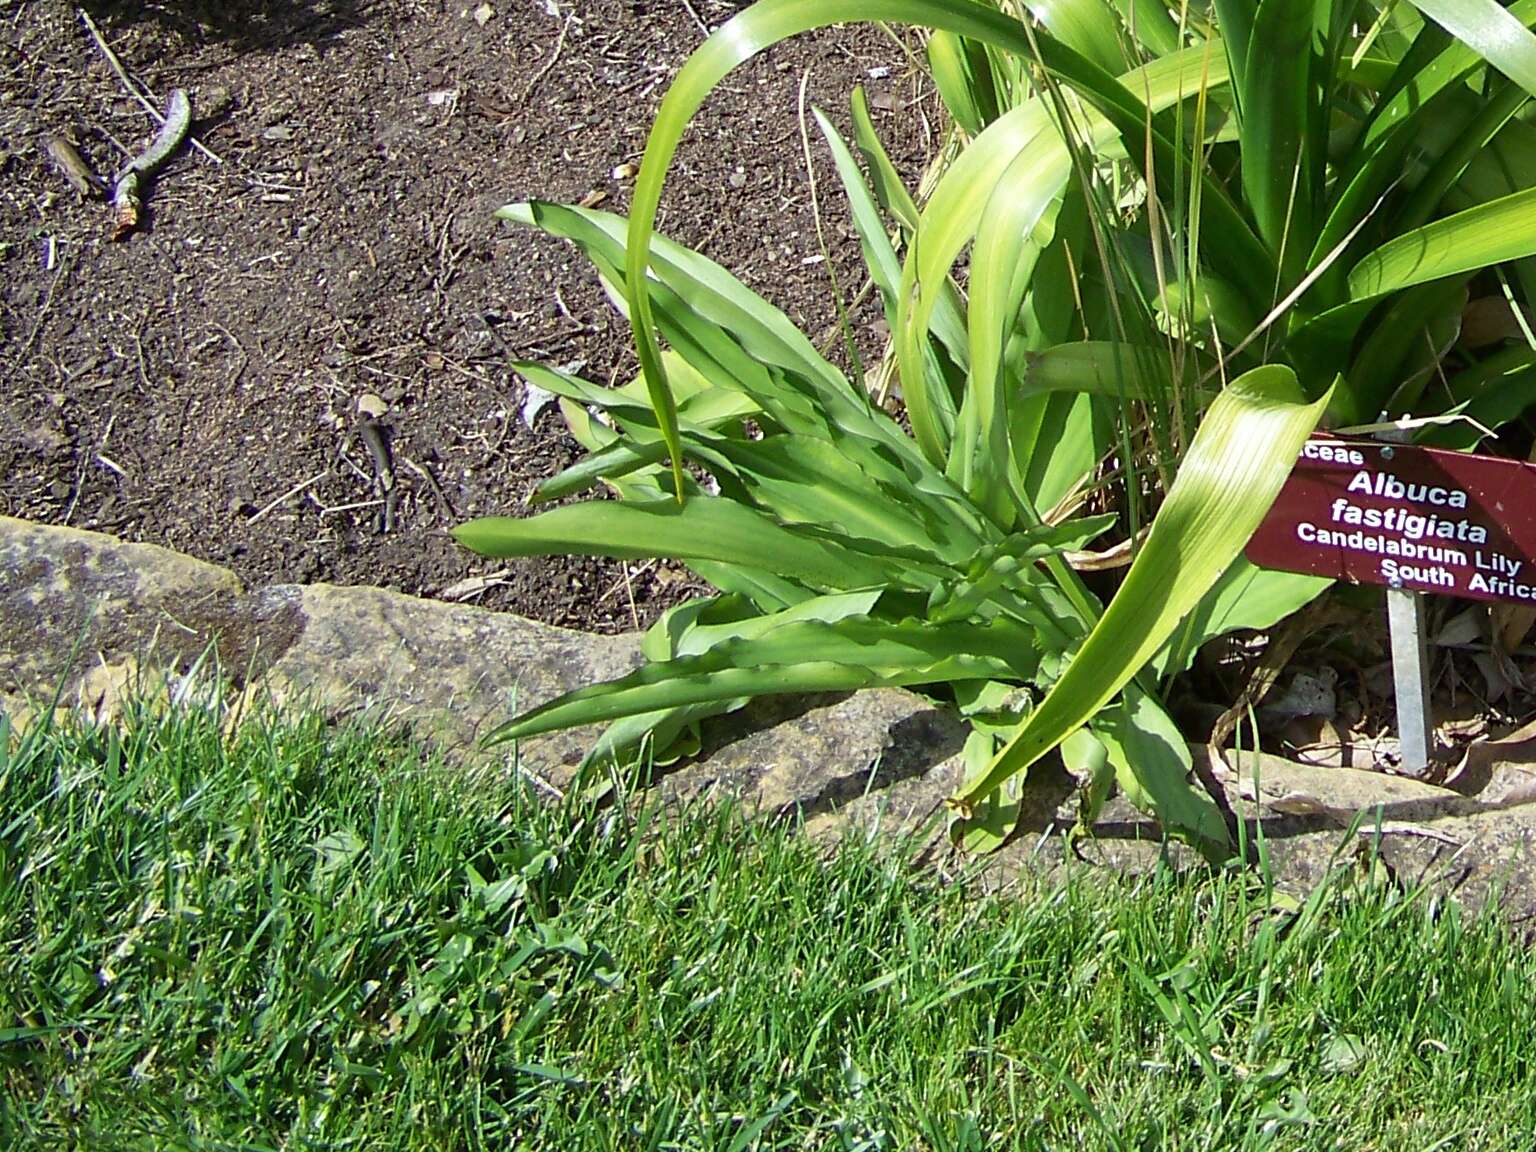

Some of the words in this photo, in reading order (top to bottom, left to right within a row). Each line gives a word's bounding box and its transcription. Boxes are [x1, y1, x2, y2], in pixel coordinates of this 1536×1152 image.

[1348, 471, 1467, 509] Albuca
[1331, 498, 1487, 544] fastigiata
[1297, 523, 1467, 566] Candelabrum
[1475, 550, 1522, 576] Lily
[1381, 559, 1454, 587] South
